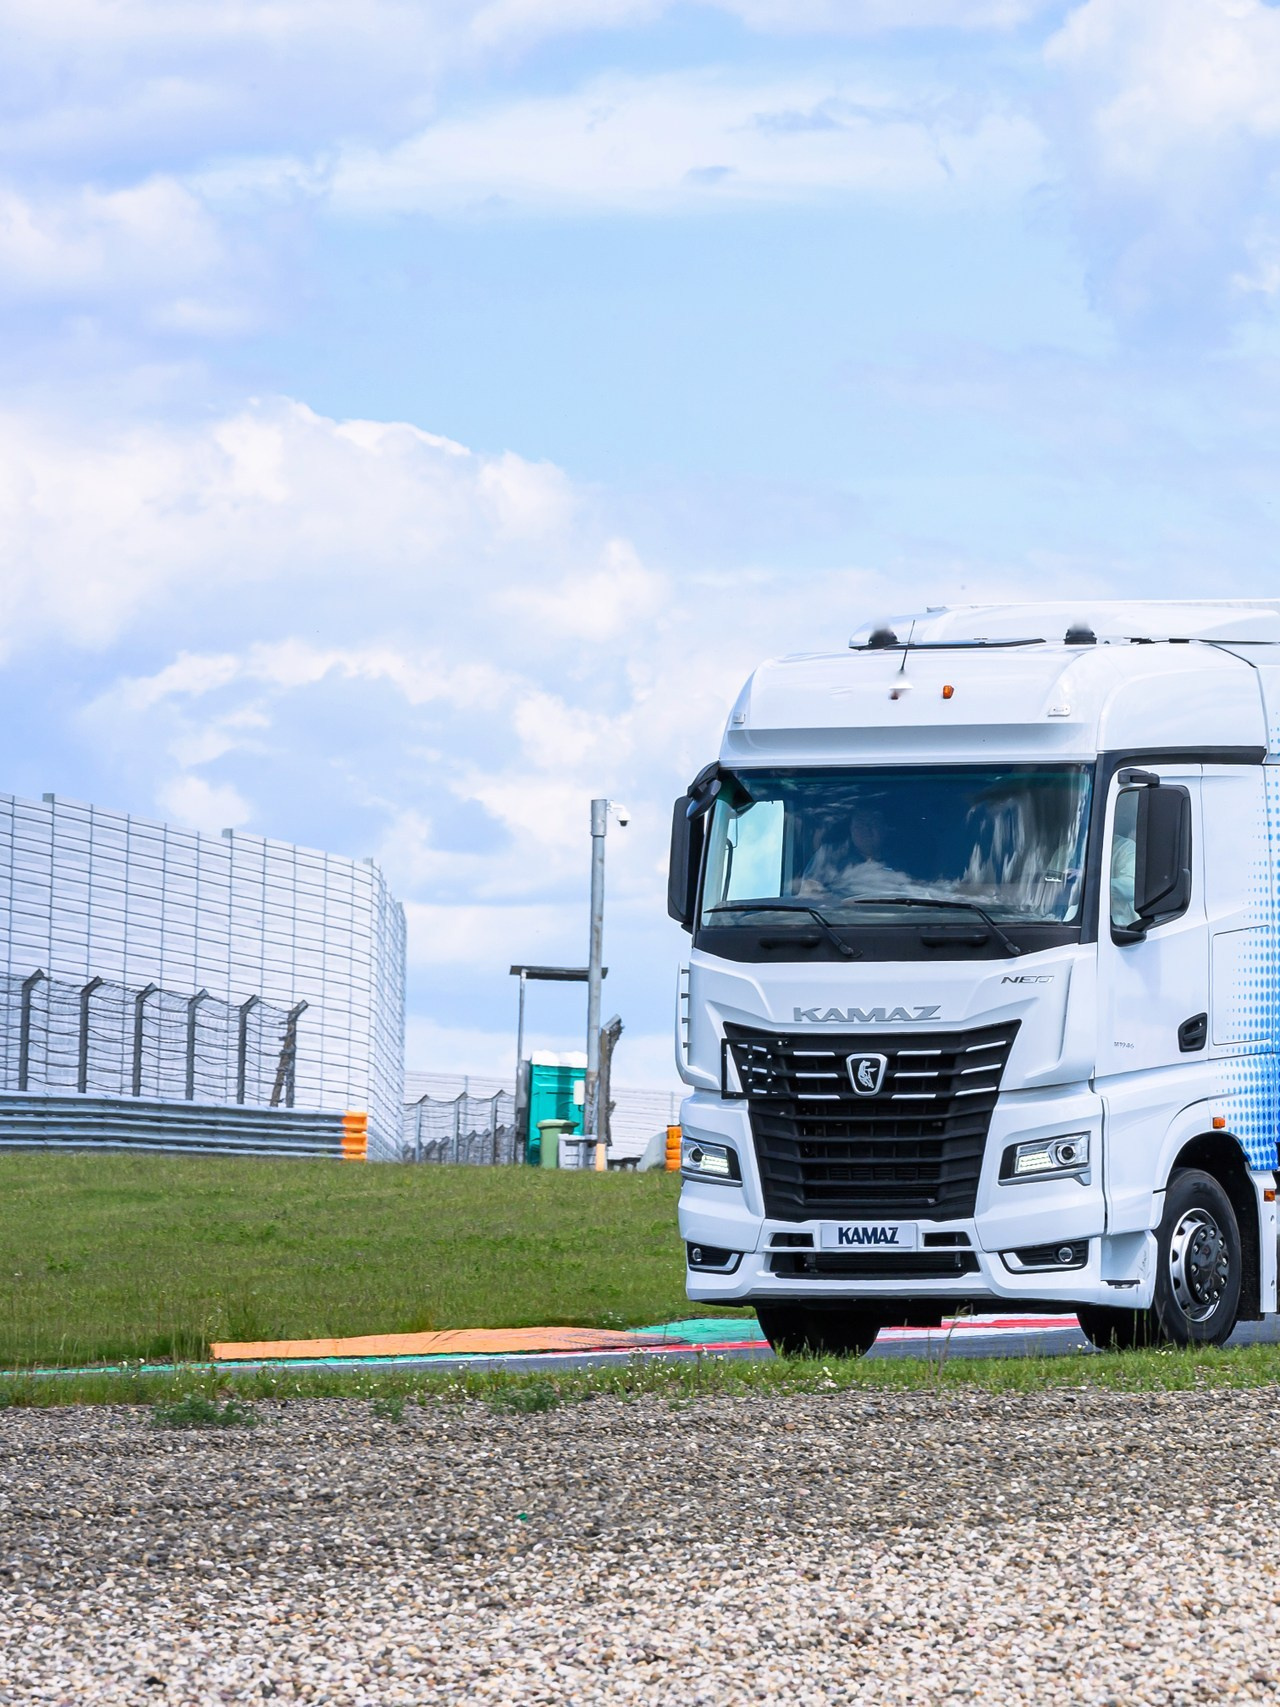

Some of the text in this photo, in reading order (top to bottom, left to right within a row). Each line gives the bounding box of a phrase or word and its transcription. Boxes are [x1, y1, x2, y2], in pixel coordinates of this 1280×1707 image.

[1000, 975, 1055, 985] NEO
[793, 1005, 942, 1023] KAMAZ
[838, 1227, 899, 1245] KAMAZ
